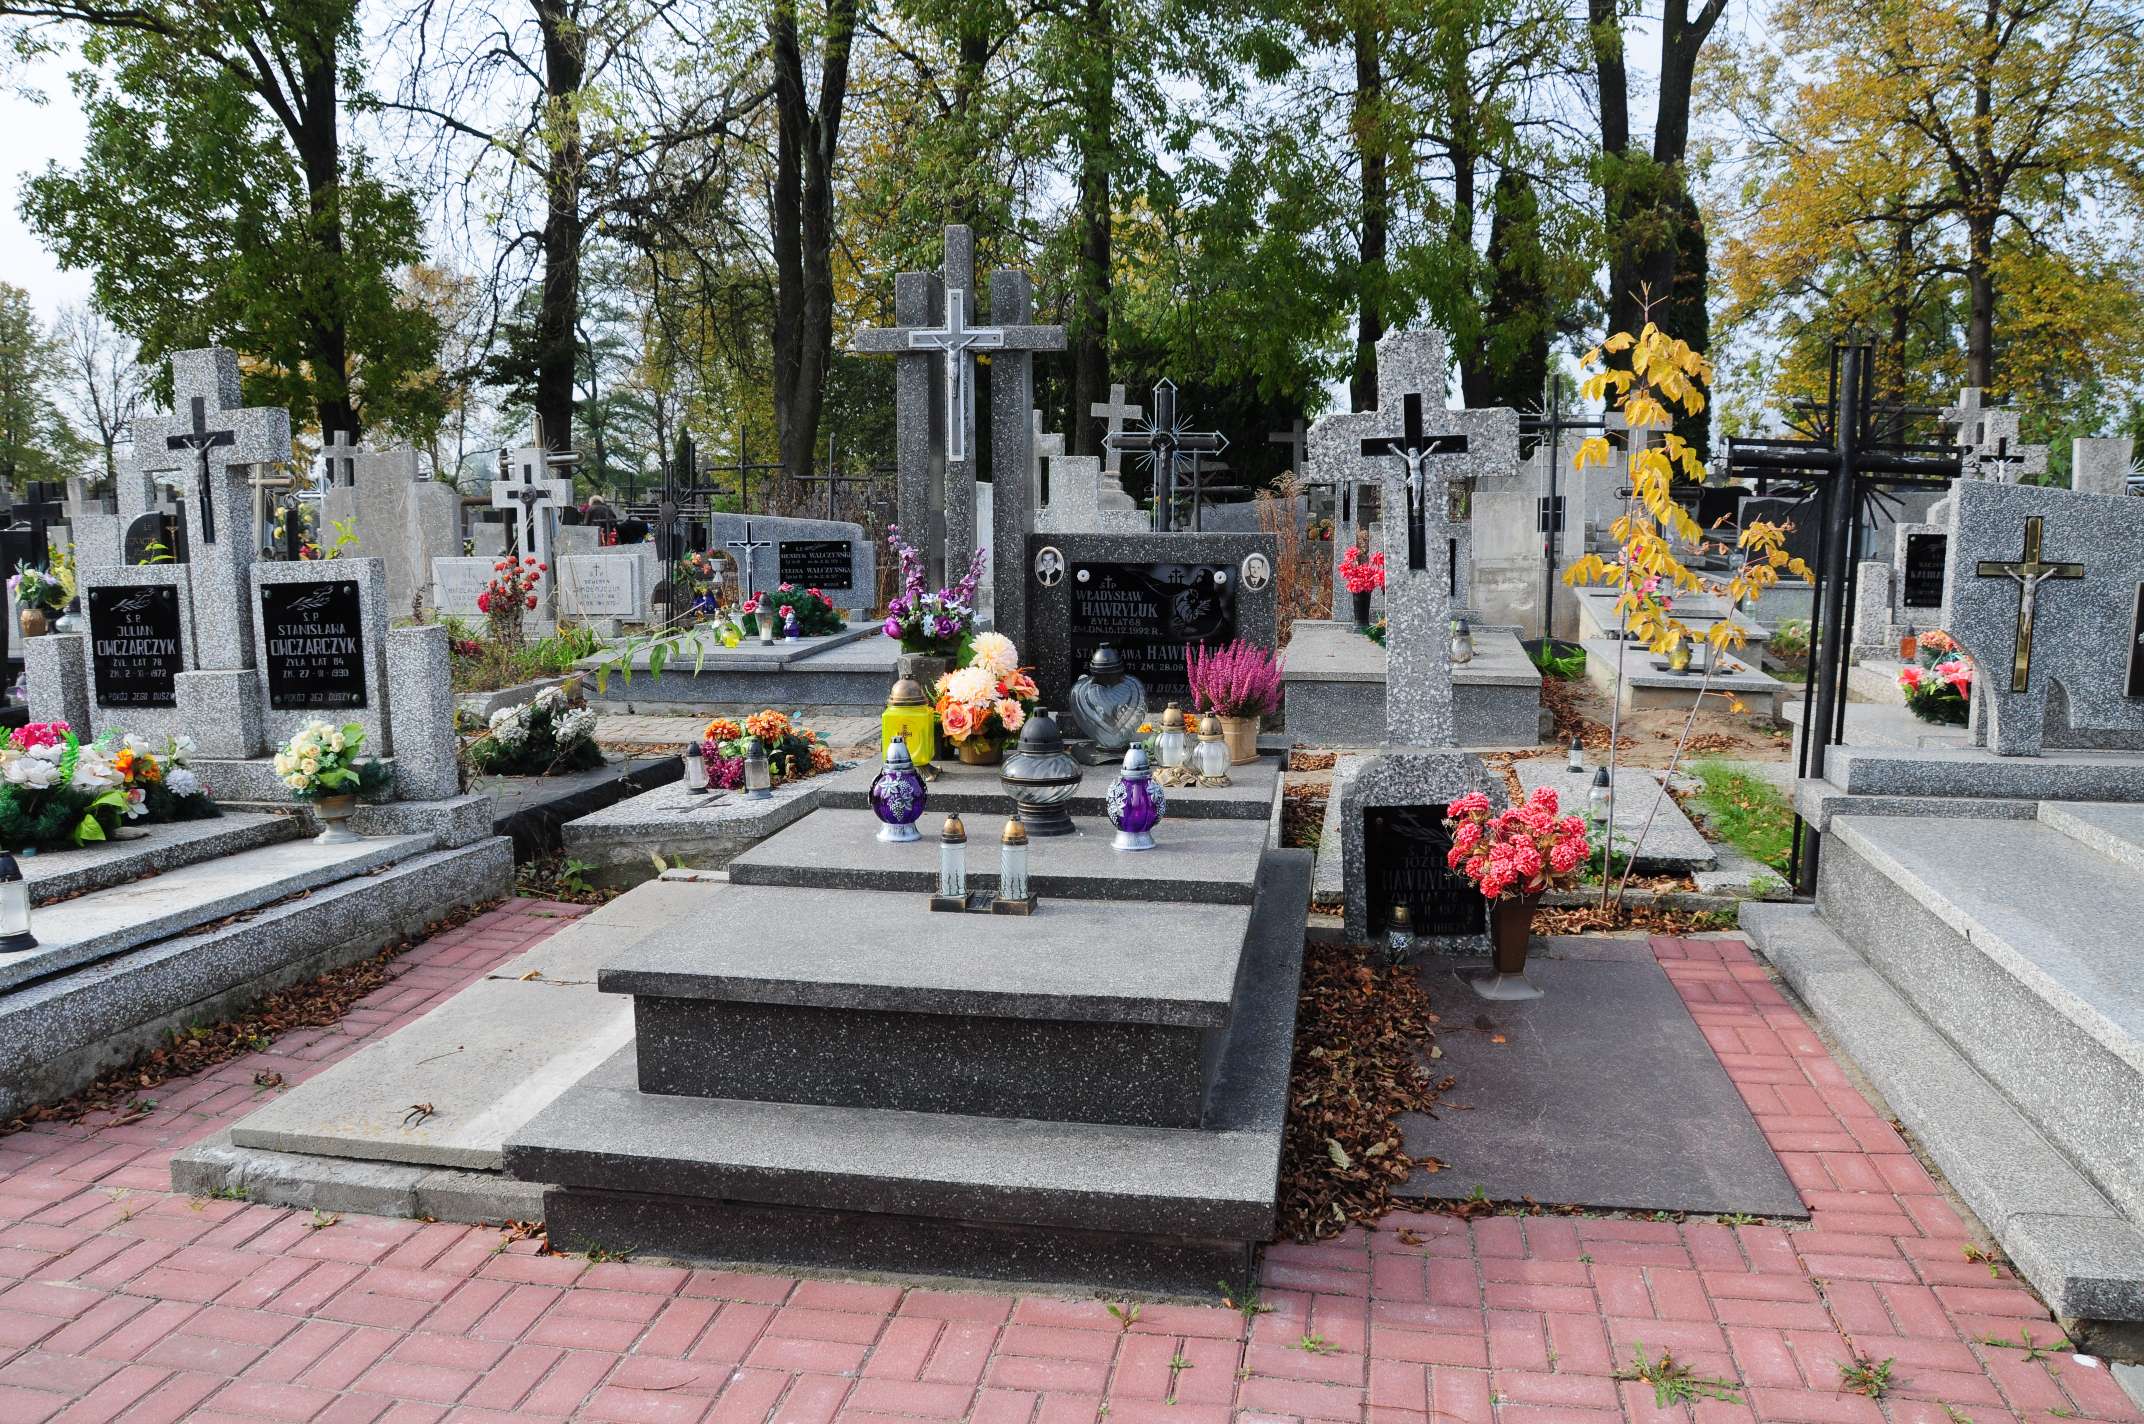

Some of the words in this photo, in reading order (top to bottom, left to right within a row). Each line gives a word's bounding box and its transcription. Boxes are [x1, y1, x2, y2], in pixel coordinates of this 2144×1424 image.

[1076, 589, 1144, 602] WŁADYSŁAW
[1080, 601, 1159, 618] HAWRYLUK
[116, 625, 154, 637] JULIAN
[278, 623, 346, 636] STANISŁAWA
[96, 638, 176, 656] OWCZARCZYK
[269, 637, 357, 656] OWCZARCZYK
[132, 657, 147, 667] LAT
[153, 657, 162, 667] 78
[312, 657, 327, 667] LAT
